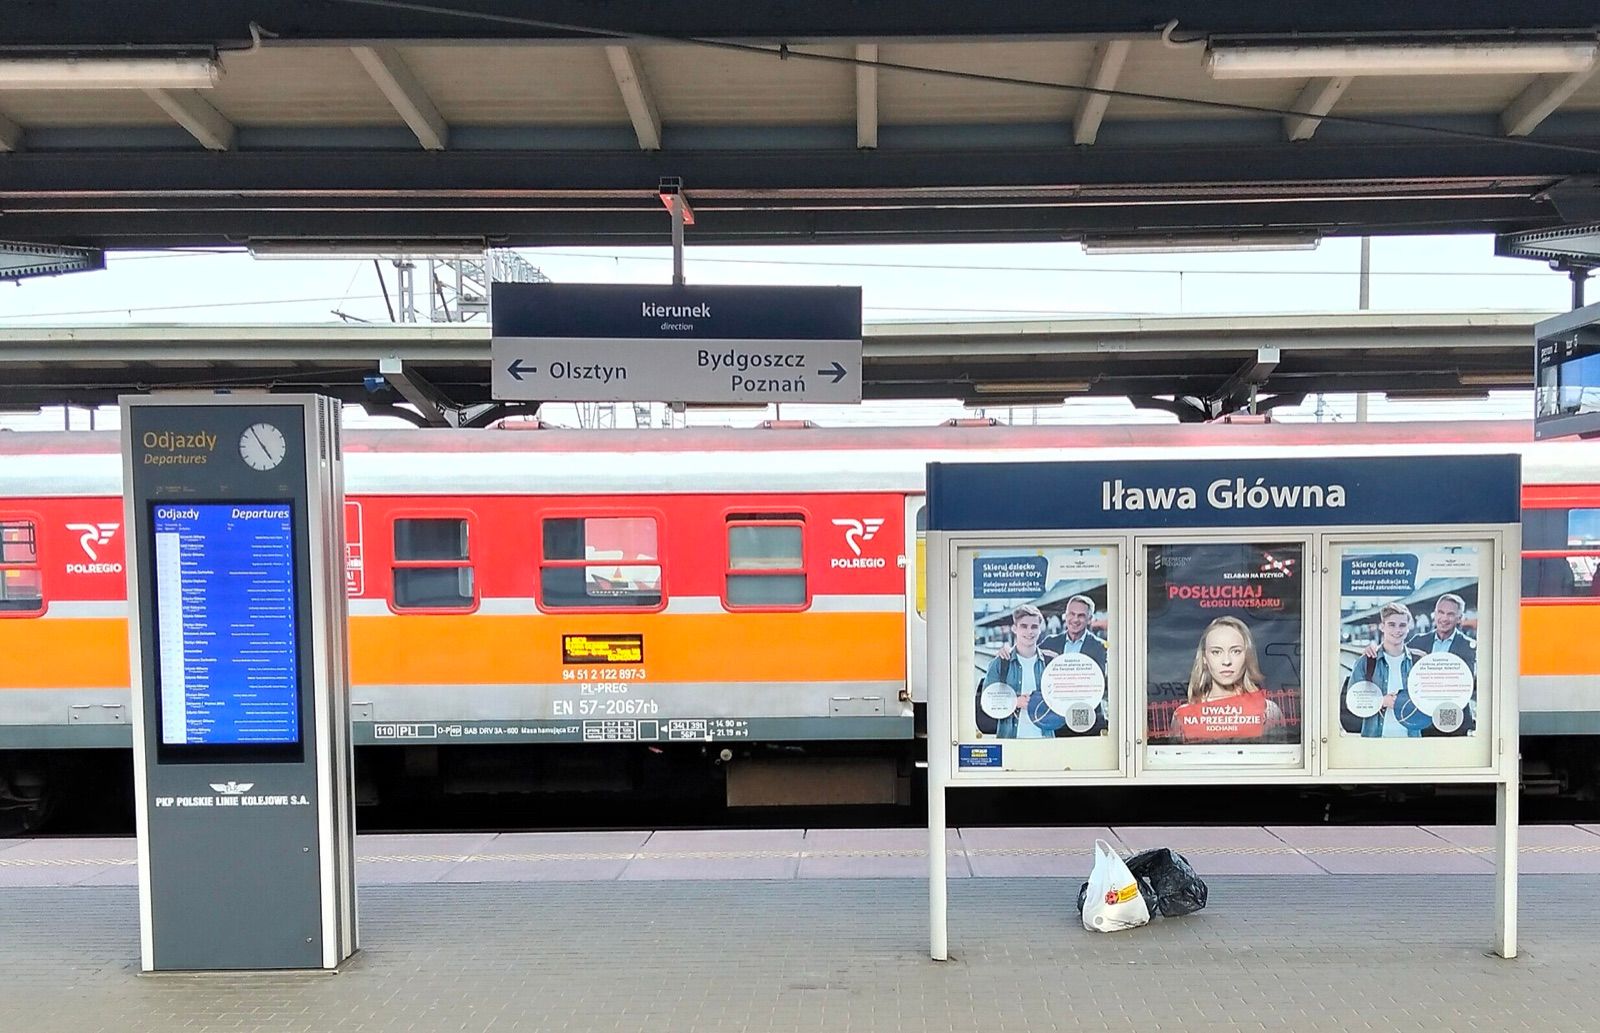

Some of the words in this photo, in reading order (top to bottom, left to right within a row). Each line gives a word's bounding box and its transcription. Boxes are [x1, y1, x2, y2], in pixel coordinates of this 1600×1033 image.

[641, 302, 711, 318] kierunek
[660, 322, 694, 332] direction
[697, 350, 806, 371] Bydgoszcz
[549, 361, 627, 384] Olsztyn
[731, 375, 806, 392] Poznań
[143, 431, 217, 452] Odjazdy
[144, 453, 207, 466] Departures
[1101, 480, 1197, 511] Iława
[1206, 477, 1347, 511] Główna
[157, 508, 199, 520] Odjazdy
[231, 508, 289, 520] Departures
[830, 557, 885, 568] POLREGIO
[983, 563, 1008, 571] Skieruj
[1008, 562, 1036, 571] dziecko
[1351, 561, 1377, 569] Skieruj
[1377, 560, 1405, 568] dziecko
[66, 563, 122, 574] POLREGIO
[992, 570, 1025, 578] właściwe
[1025, 570, 1043, 578] tory.
[1394, 568, 1412, 576] tory.
[1169, 584, 1263, 599] POSŁUCHAJ
[1200, 599, 1230, 608] GŁOSU
[1231, 599, 1281, 608] ROZSĄDKU
[562, 669, 575, 680] 94
[577, 669, 588, 680] 51
[591, 669, 597, 679] 2
[600, 669, 617, 679] 122
[619, 669, 646, 679] 897-3
[581, 683, 628, 693] PL-PREG
[553, 700, 573, 715] EN
[579, 700, 659, 714] 57-2067rb
[1202, 705, 1243, 715] UWAŻAJ
[1183, 717, 1198, 725] NA
[1200, 715, 1261, 725] PRZEJEŹDZIE
[377, 727, 393, 735] 110
[400, 727, 416, 736] PL
[155, 797, 174, 807] PKP
[176, 797, 214, 807] POLSKIE
[215, 796, 239, 807] LINIE
[241, 796, 288, 806] KOLEJOWE
[290, 795, 310, 805] S.A.
